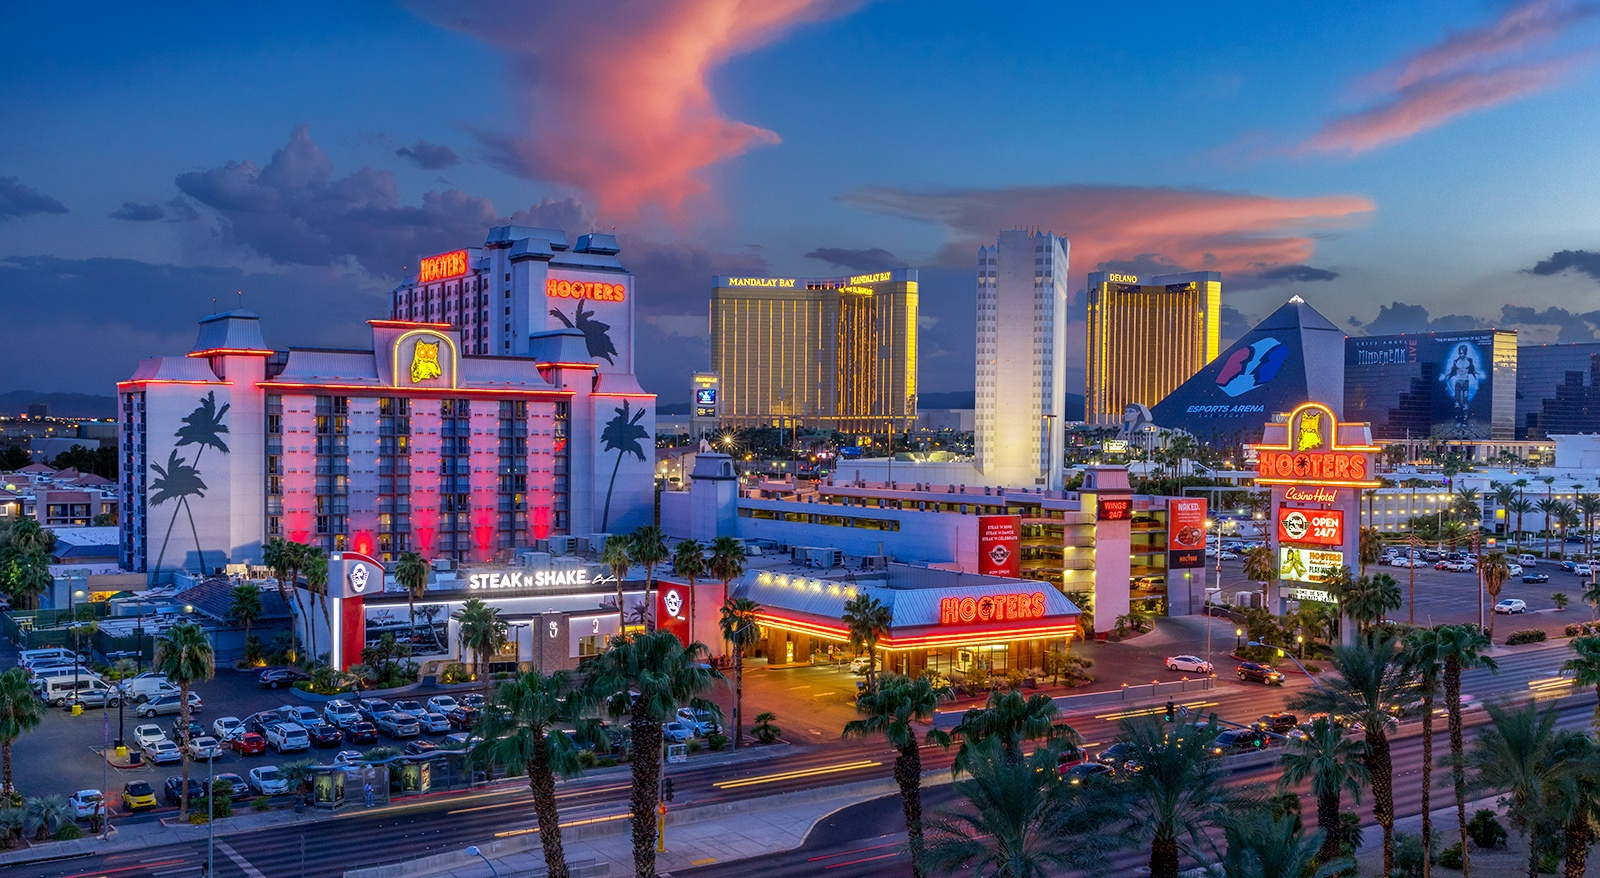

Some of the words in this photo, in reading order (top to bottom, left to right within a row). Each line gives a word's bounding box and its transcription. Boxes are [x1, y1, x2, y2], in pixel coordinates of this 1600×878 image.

[420, 249, 468, 283] HOOTERS
[729, 278, 778, 286] MANDALAY
[779, 278, 796, 287] BAY
[850, 273, 880, 285] MANDALAY
[880, 272, 891, 280] BAY
[1110, 273, 1138, 284] DELANO
[546, 278, 625, 302] HOOTERS
[1358, 348, 1406, 365] MINDFREAK
[1408, 340, 1417, 363] LIVE
[1259, 452, 1366, 480] HOOTERS
[1285, 486, 1313, 500] Casino
[1313, 487, 1337, 502] Hotel
[1104, 502, 1127, 510] WINGS
[1312, 517, 1338, 527] OPEN
[1314, 528, 1336, 537] 24/7
[1310, 552, 1341, 562] HOOTERS
[469, 572, 522, 590] STEAK
[524, 576, 533, 587] N
[535, 570, 587, 586] SHAKE
[941, 592, 1045, 624] HOOTERS
